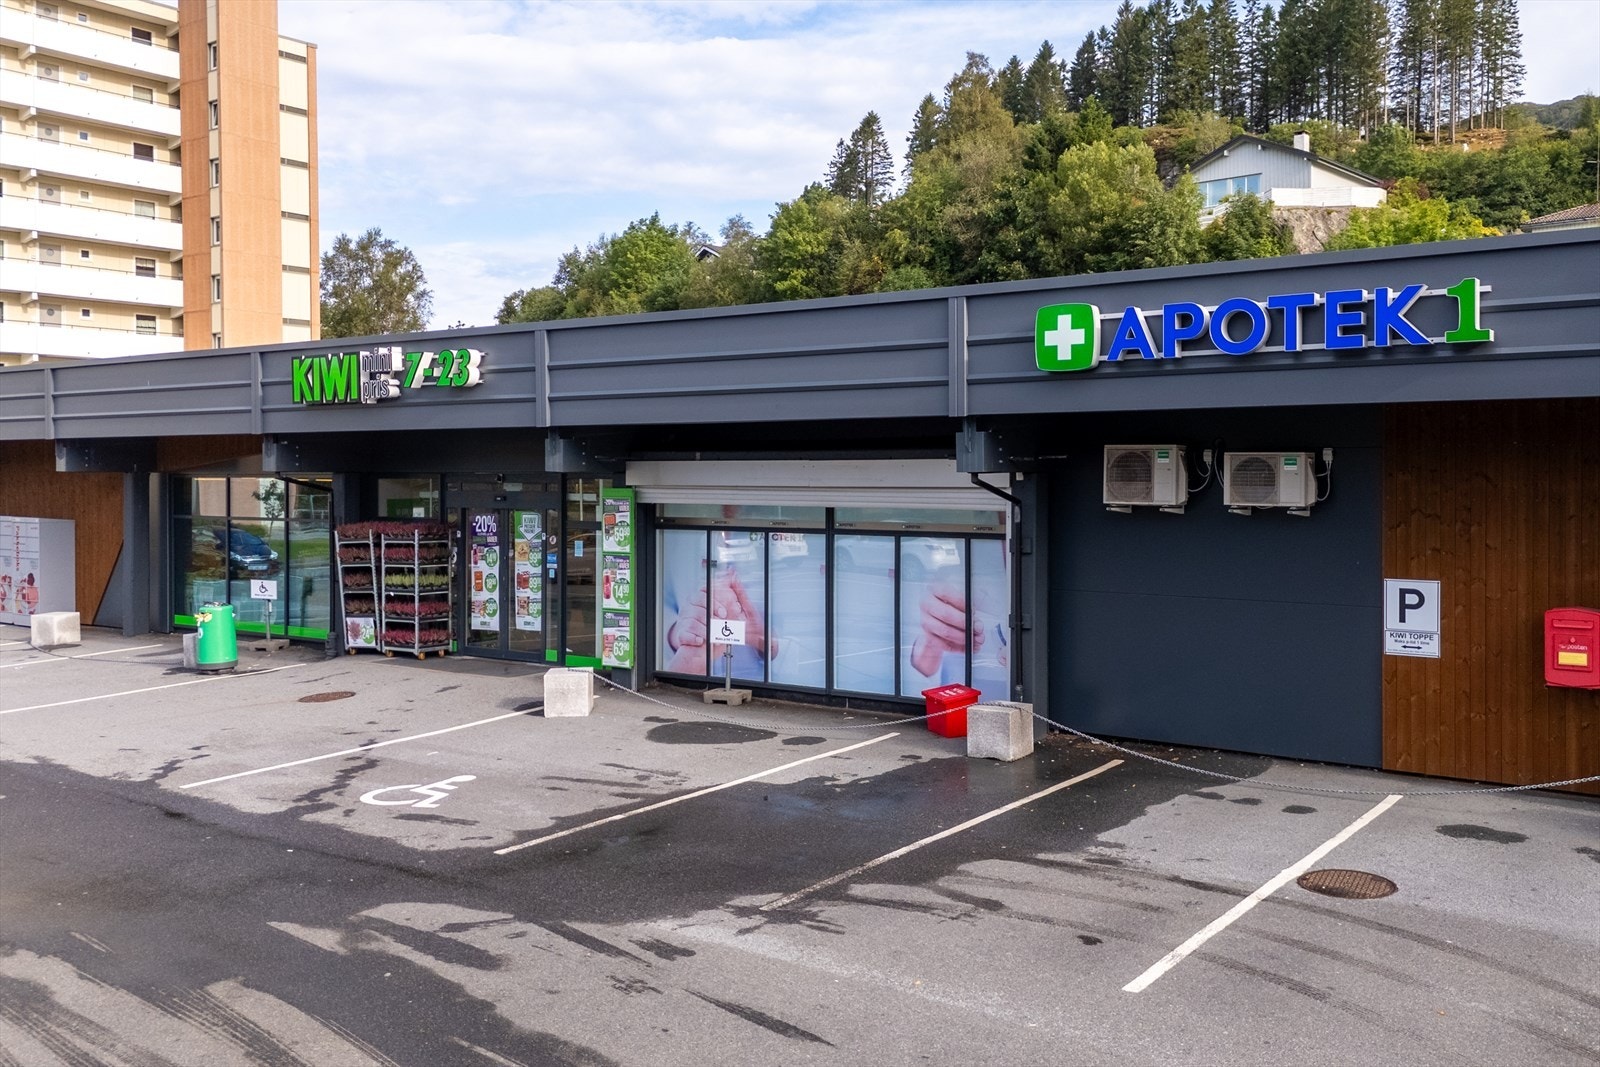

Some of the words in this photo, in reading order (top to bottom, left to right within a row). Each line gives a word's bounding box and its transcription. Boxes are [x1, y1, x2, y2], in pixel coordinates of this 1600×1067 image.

[1106, 284, 1434, 361] APOTEK
[1444, 277, 1495, 344] 1
[293, 353, 359, 403] KIWI
[362, 348, 392, 372] mini
[404, 348, 473, 389] 7-23
[362, 374, 390, 403] pris
[472, 515, 497, 533] -20%
[1399, 588, 1425, 623] P
[1409, 633, 1434, 641] TOPPE
[1567, 644, 1588, 652] posten
